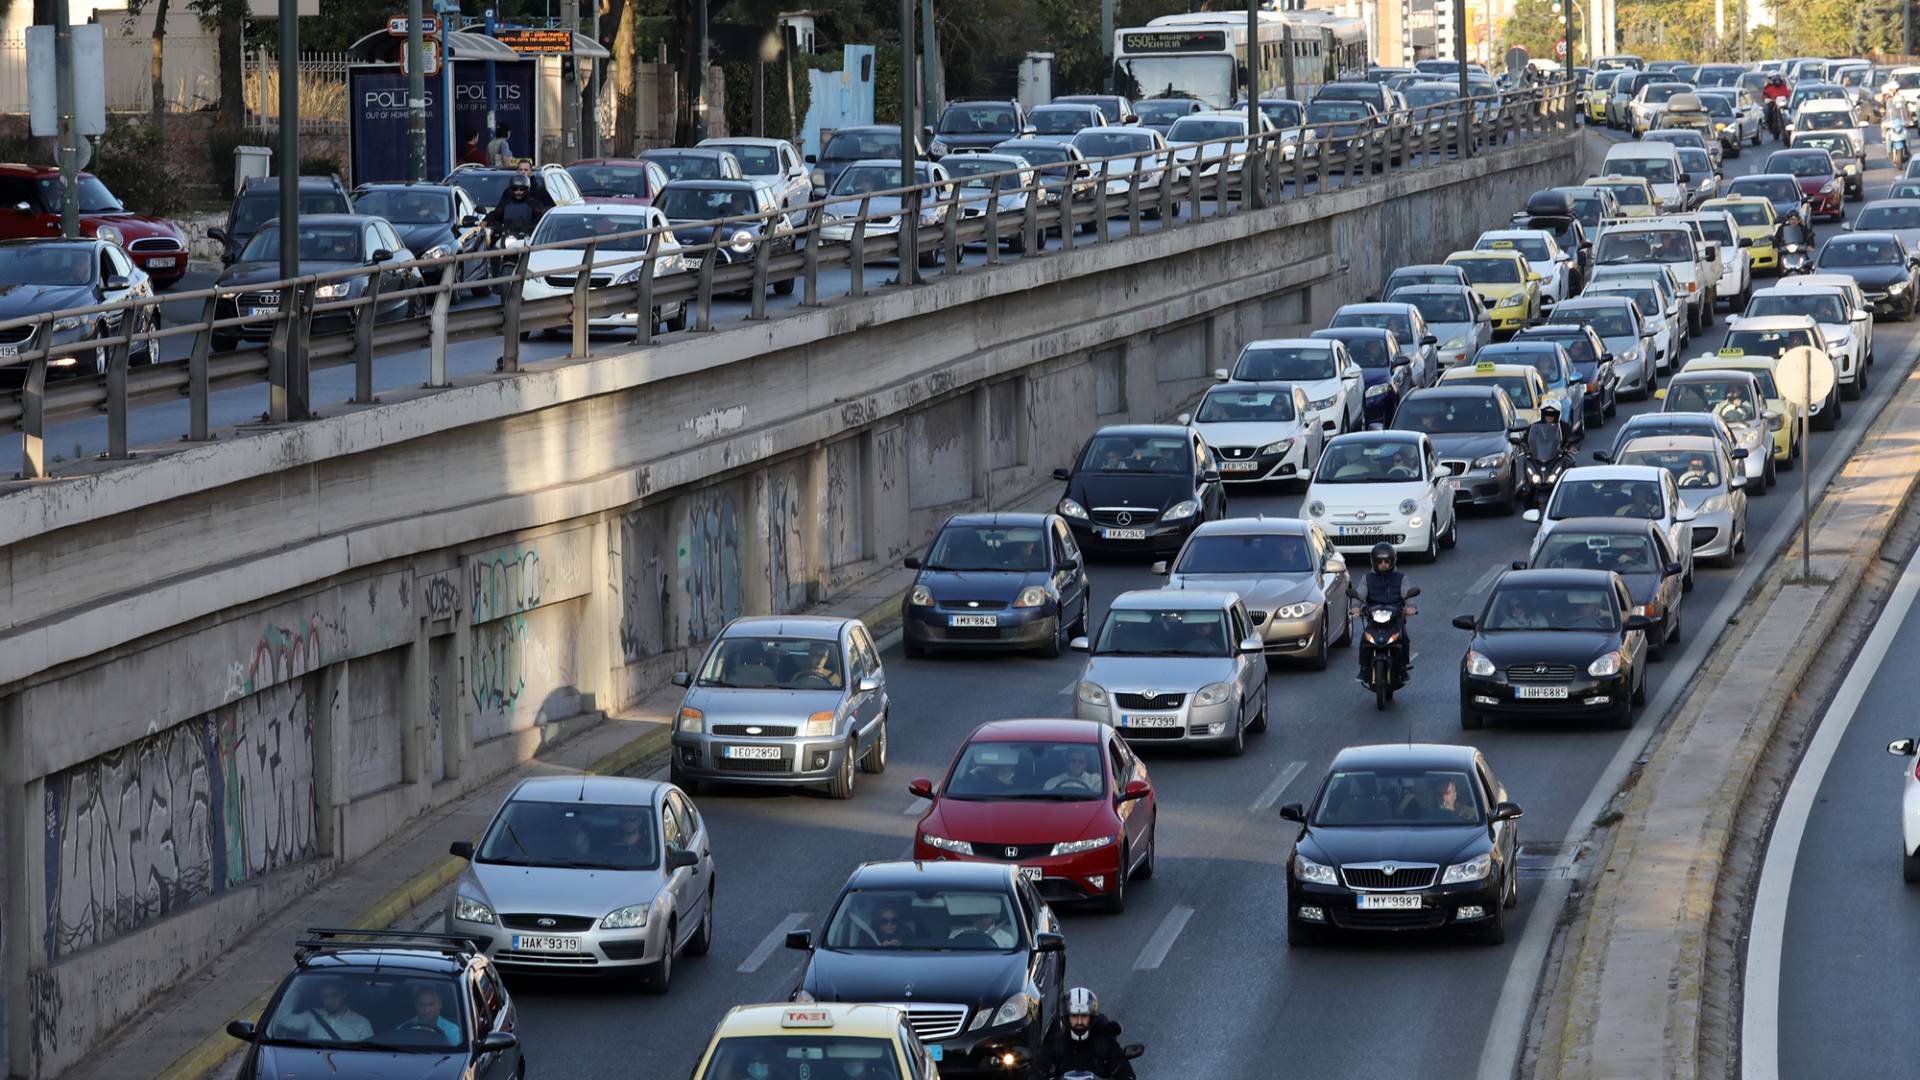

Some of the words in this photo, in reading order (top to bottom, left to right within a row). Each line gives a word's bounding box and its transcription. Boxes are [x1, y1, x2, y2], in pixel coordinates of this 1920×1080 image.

[1127, 34, 1148, 48] 550
[456, 84, 521, 100] POLTIS
[365, 90, 433, 108] POLIS
[365, 111, 379, 120] OUT
[380, 111, 389, 119] OF
[1543, 687, 1567, 697] 6885
[1151, 717, 1175, 726] 7399
[755, 748, 779, 758] 2850
[1368, 896, 1386, 907] IMY
[1392, 896, 1420, 907] 9987
[521, 937, 543, 949] HAK
[548, 938, 577, 950] 9319
